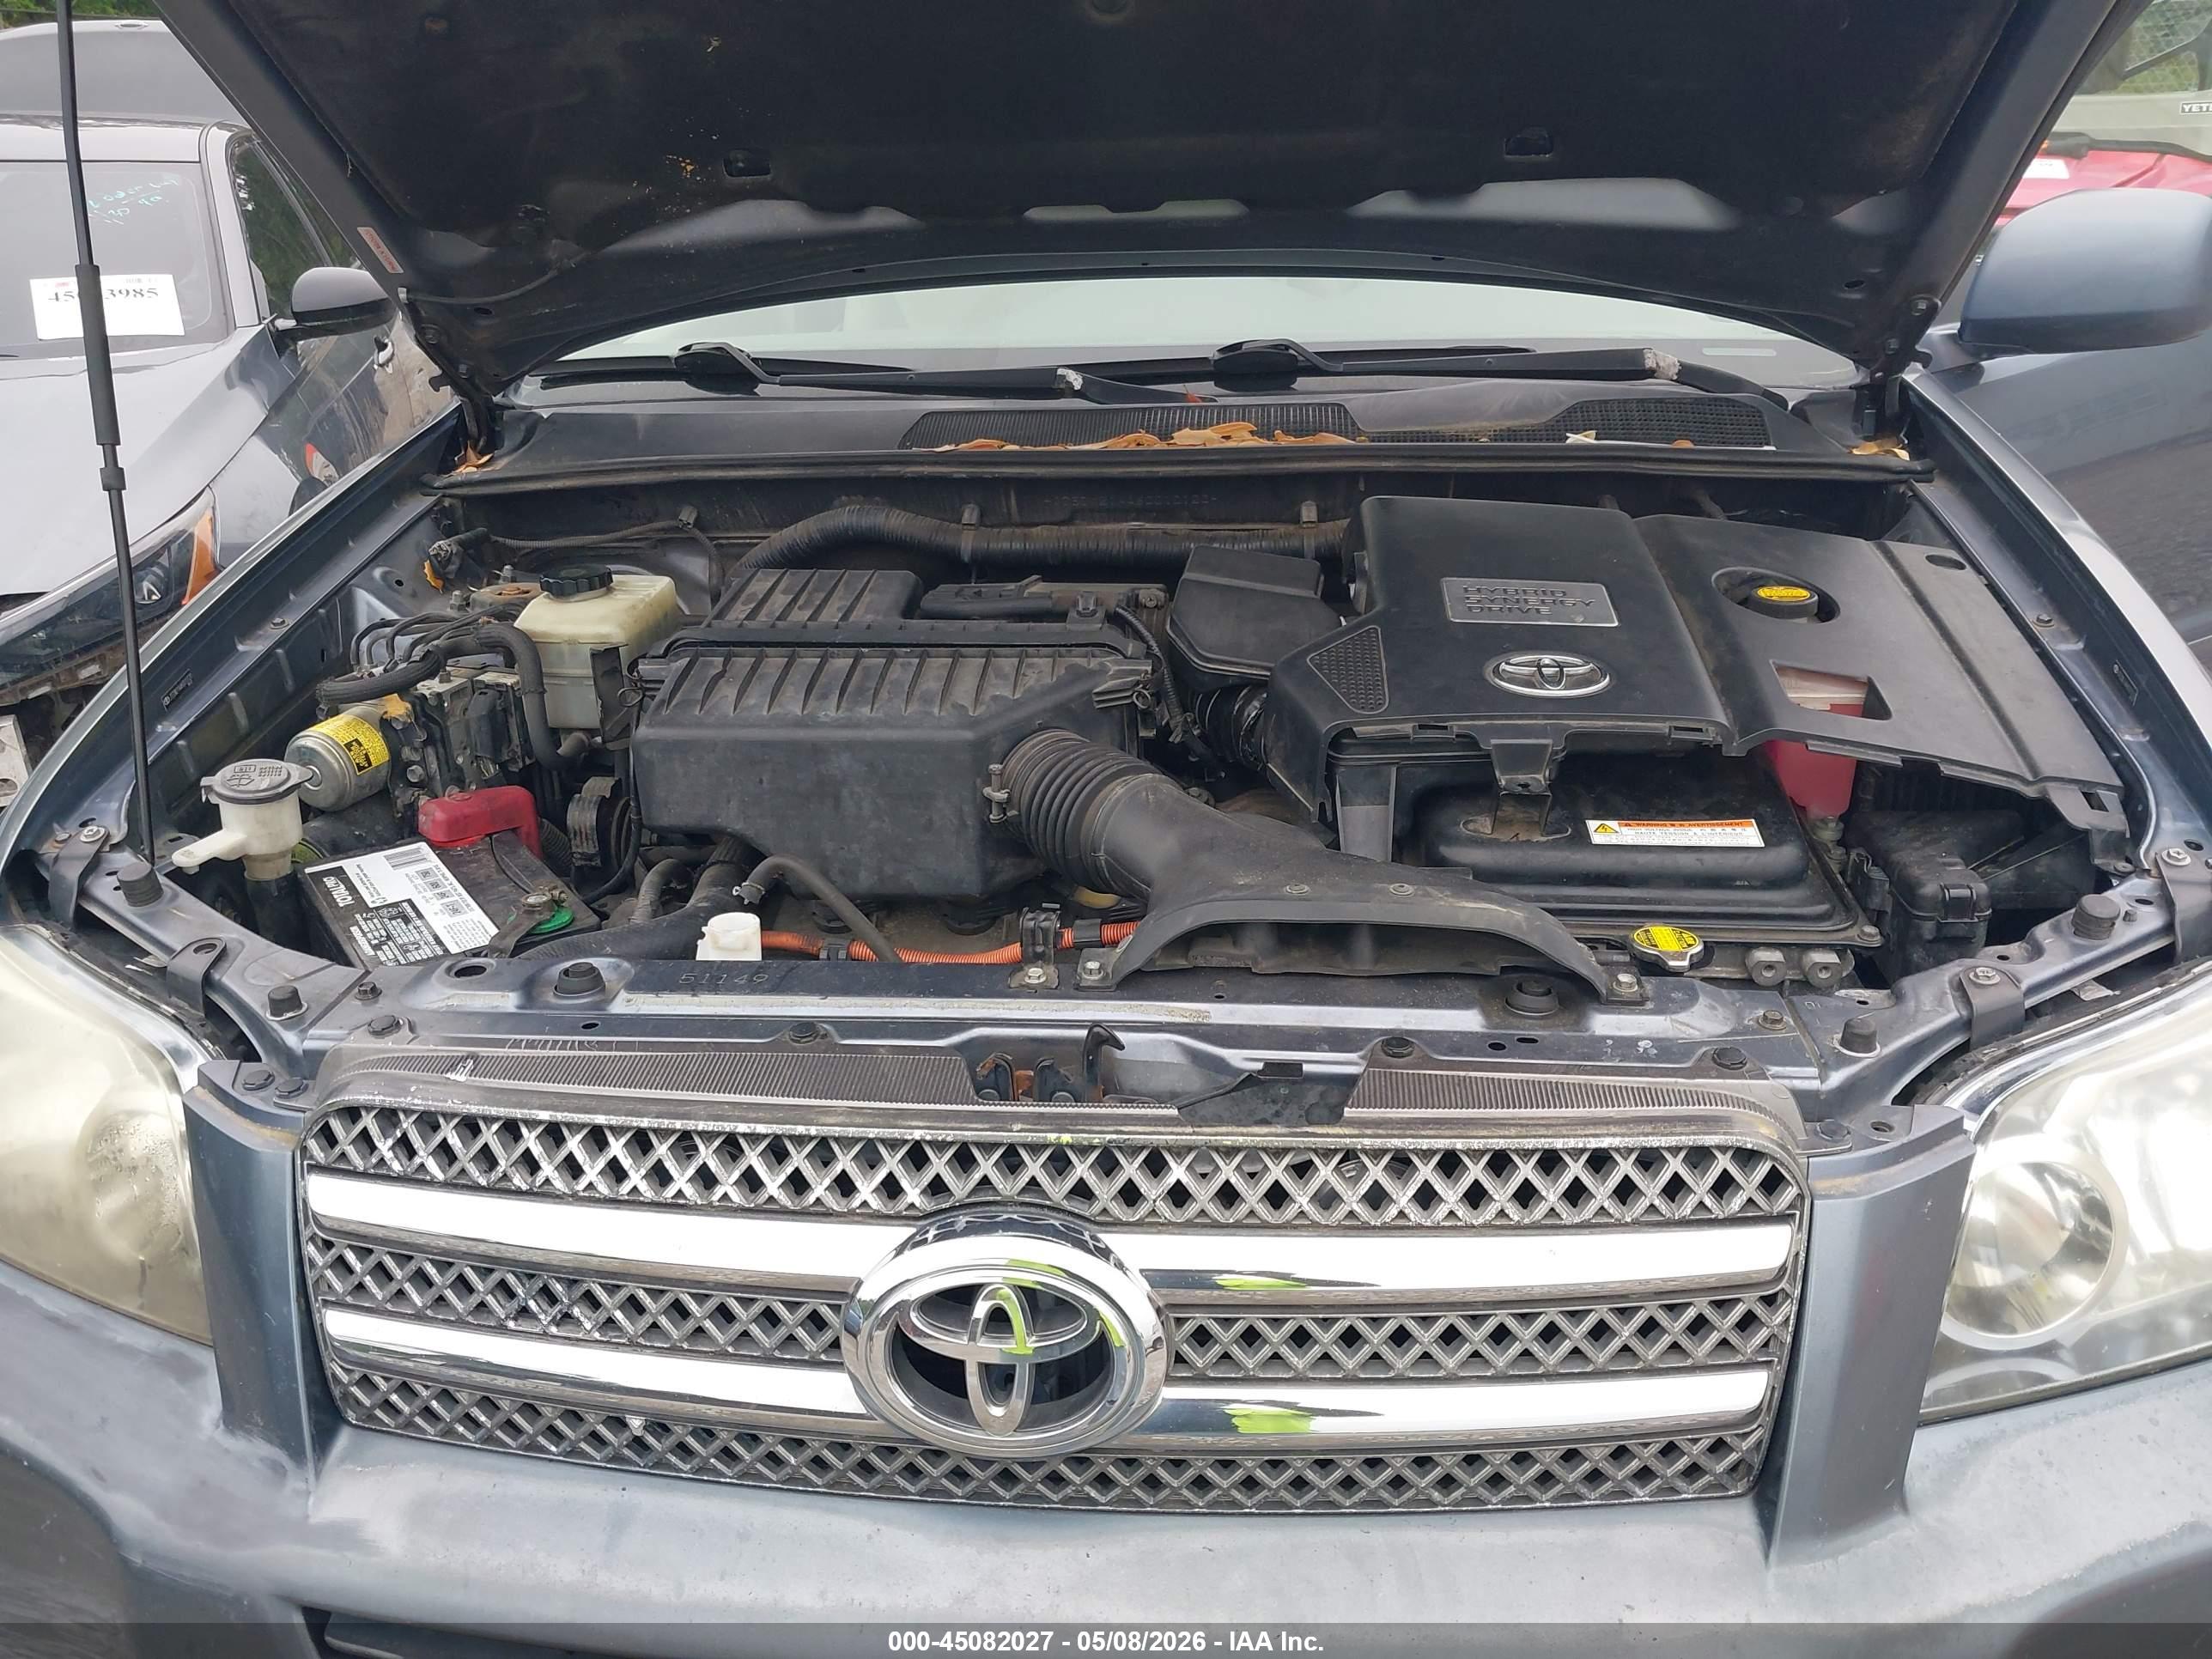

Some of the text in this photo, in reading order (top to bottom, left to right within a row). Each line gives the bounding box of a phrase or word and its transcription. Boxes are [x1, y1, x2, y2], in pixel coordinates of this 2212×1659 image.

[48, 288, 158, 301] 453985
[1462, 586, 1566, 597] HYBRID
[1464, 595, 1595, 606] SYNERGY
[1466, 605, 1553, 615] DRIVE
[322, 876, 356, 908] TOTALPRO
[678, 973, 769, 984] 51149
